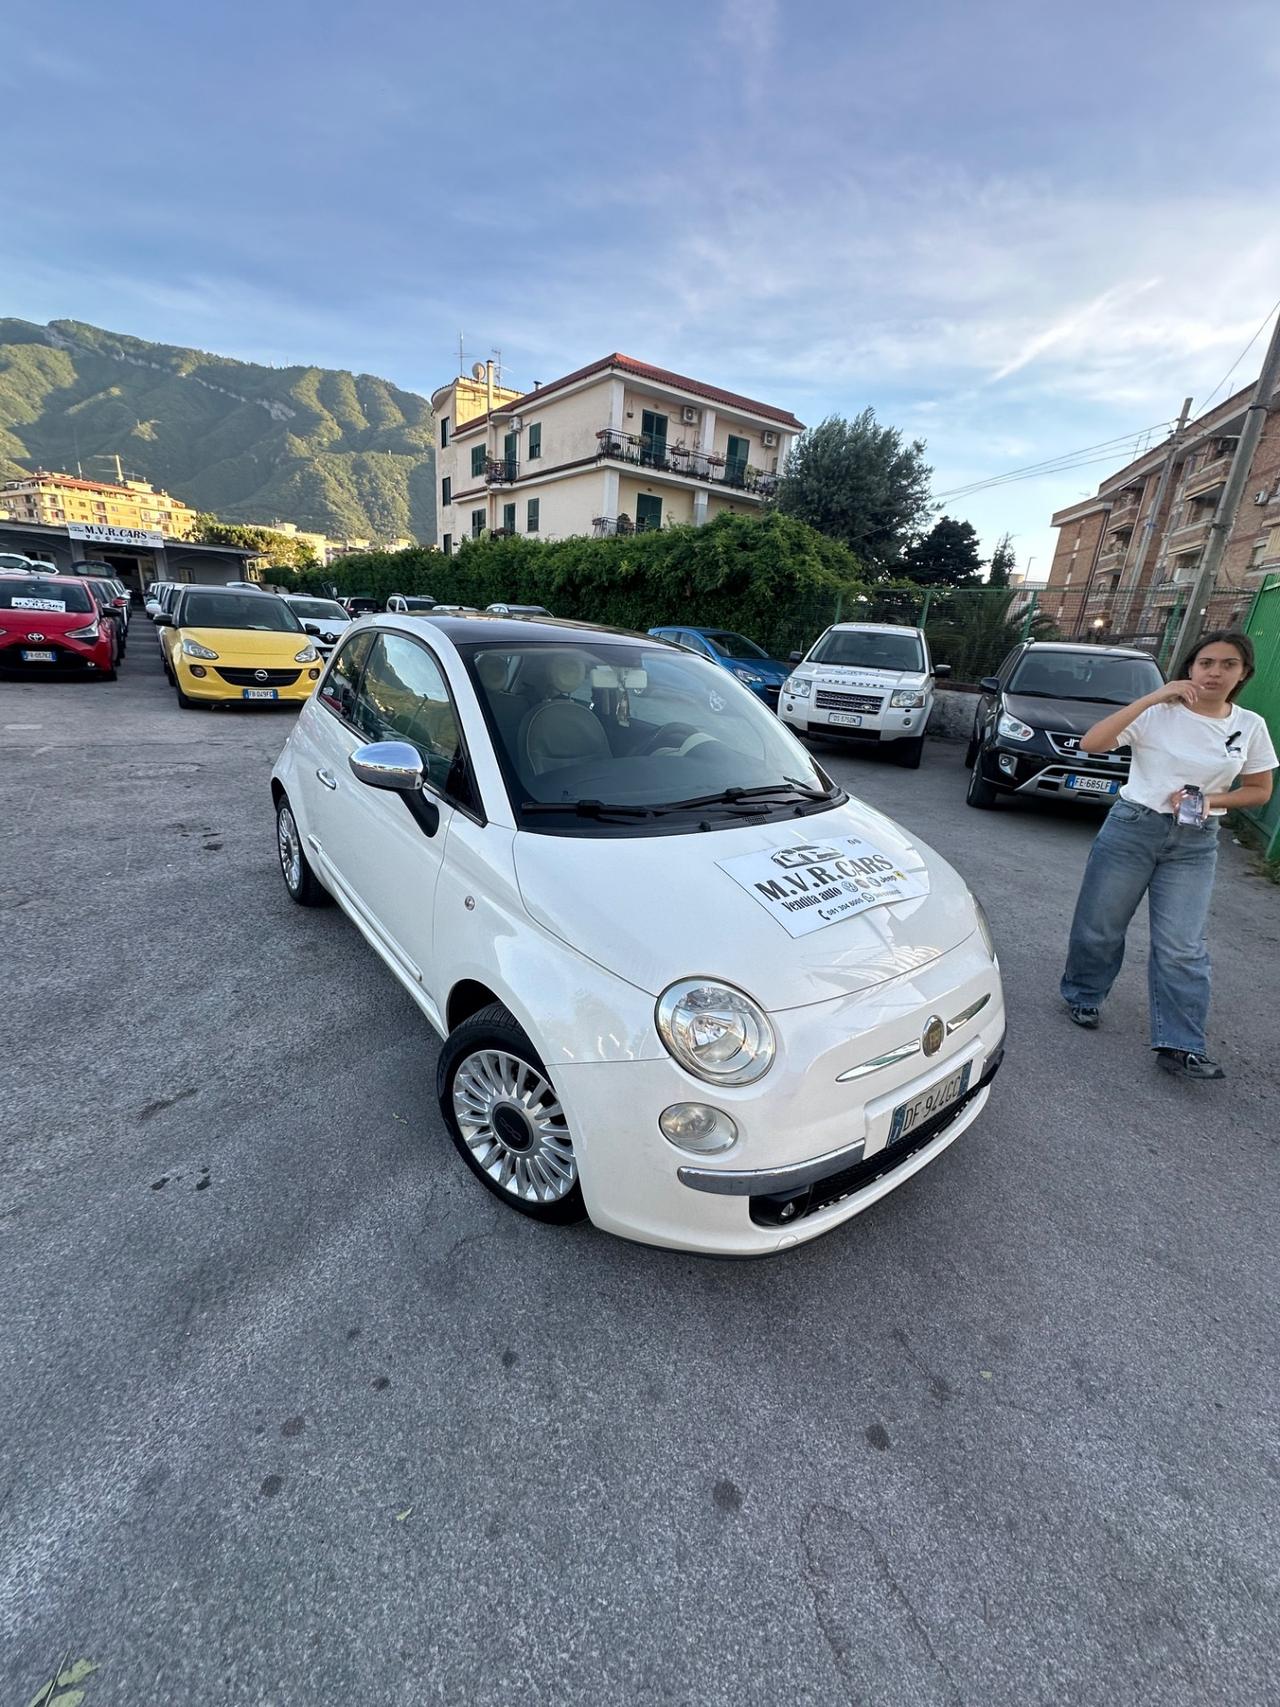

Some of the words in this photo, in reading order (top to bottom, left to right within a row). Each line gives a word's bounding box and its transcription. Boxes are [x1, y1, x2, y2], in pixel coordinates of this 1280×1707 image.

[84, 525, 147, 539] M.V.R.CARS
[1075, 777, 1085, 787] FE
[1086, 779, 1111, 791] 685LF
[754, 854, 894, 902] M.V.R.CARS
[781, 894, 819, 913] Vendita
[818, 885, 843, 902] auto
[903, 1101, 922, 1131] DF
